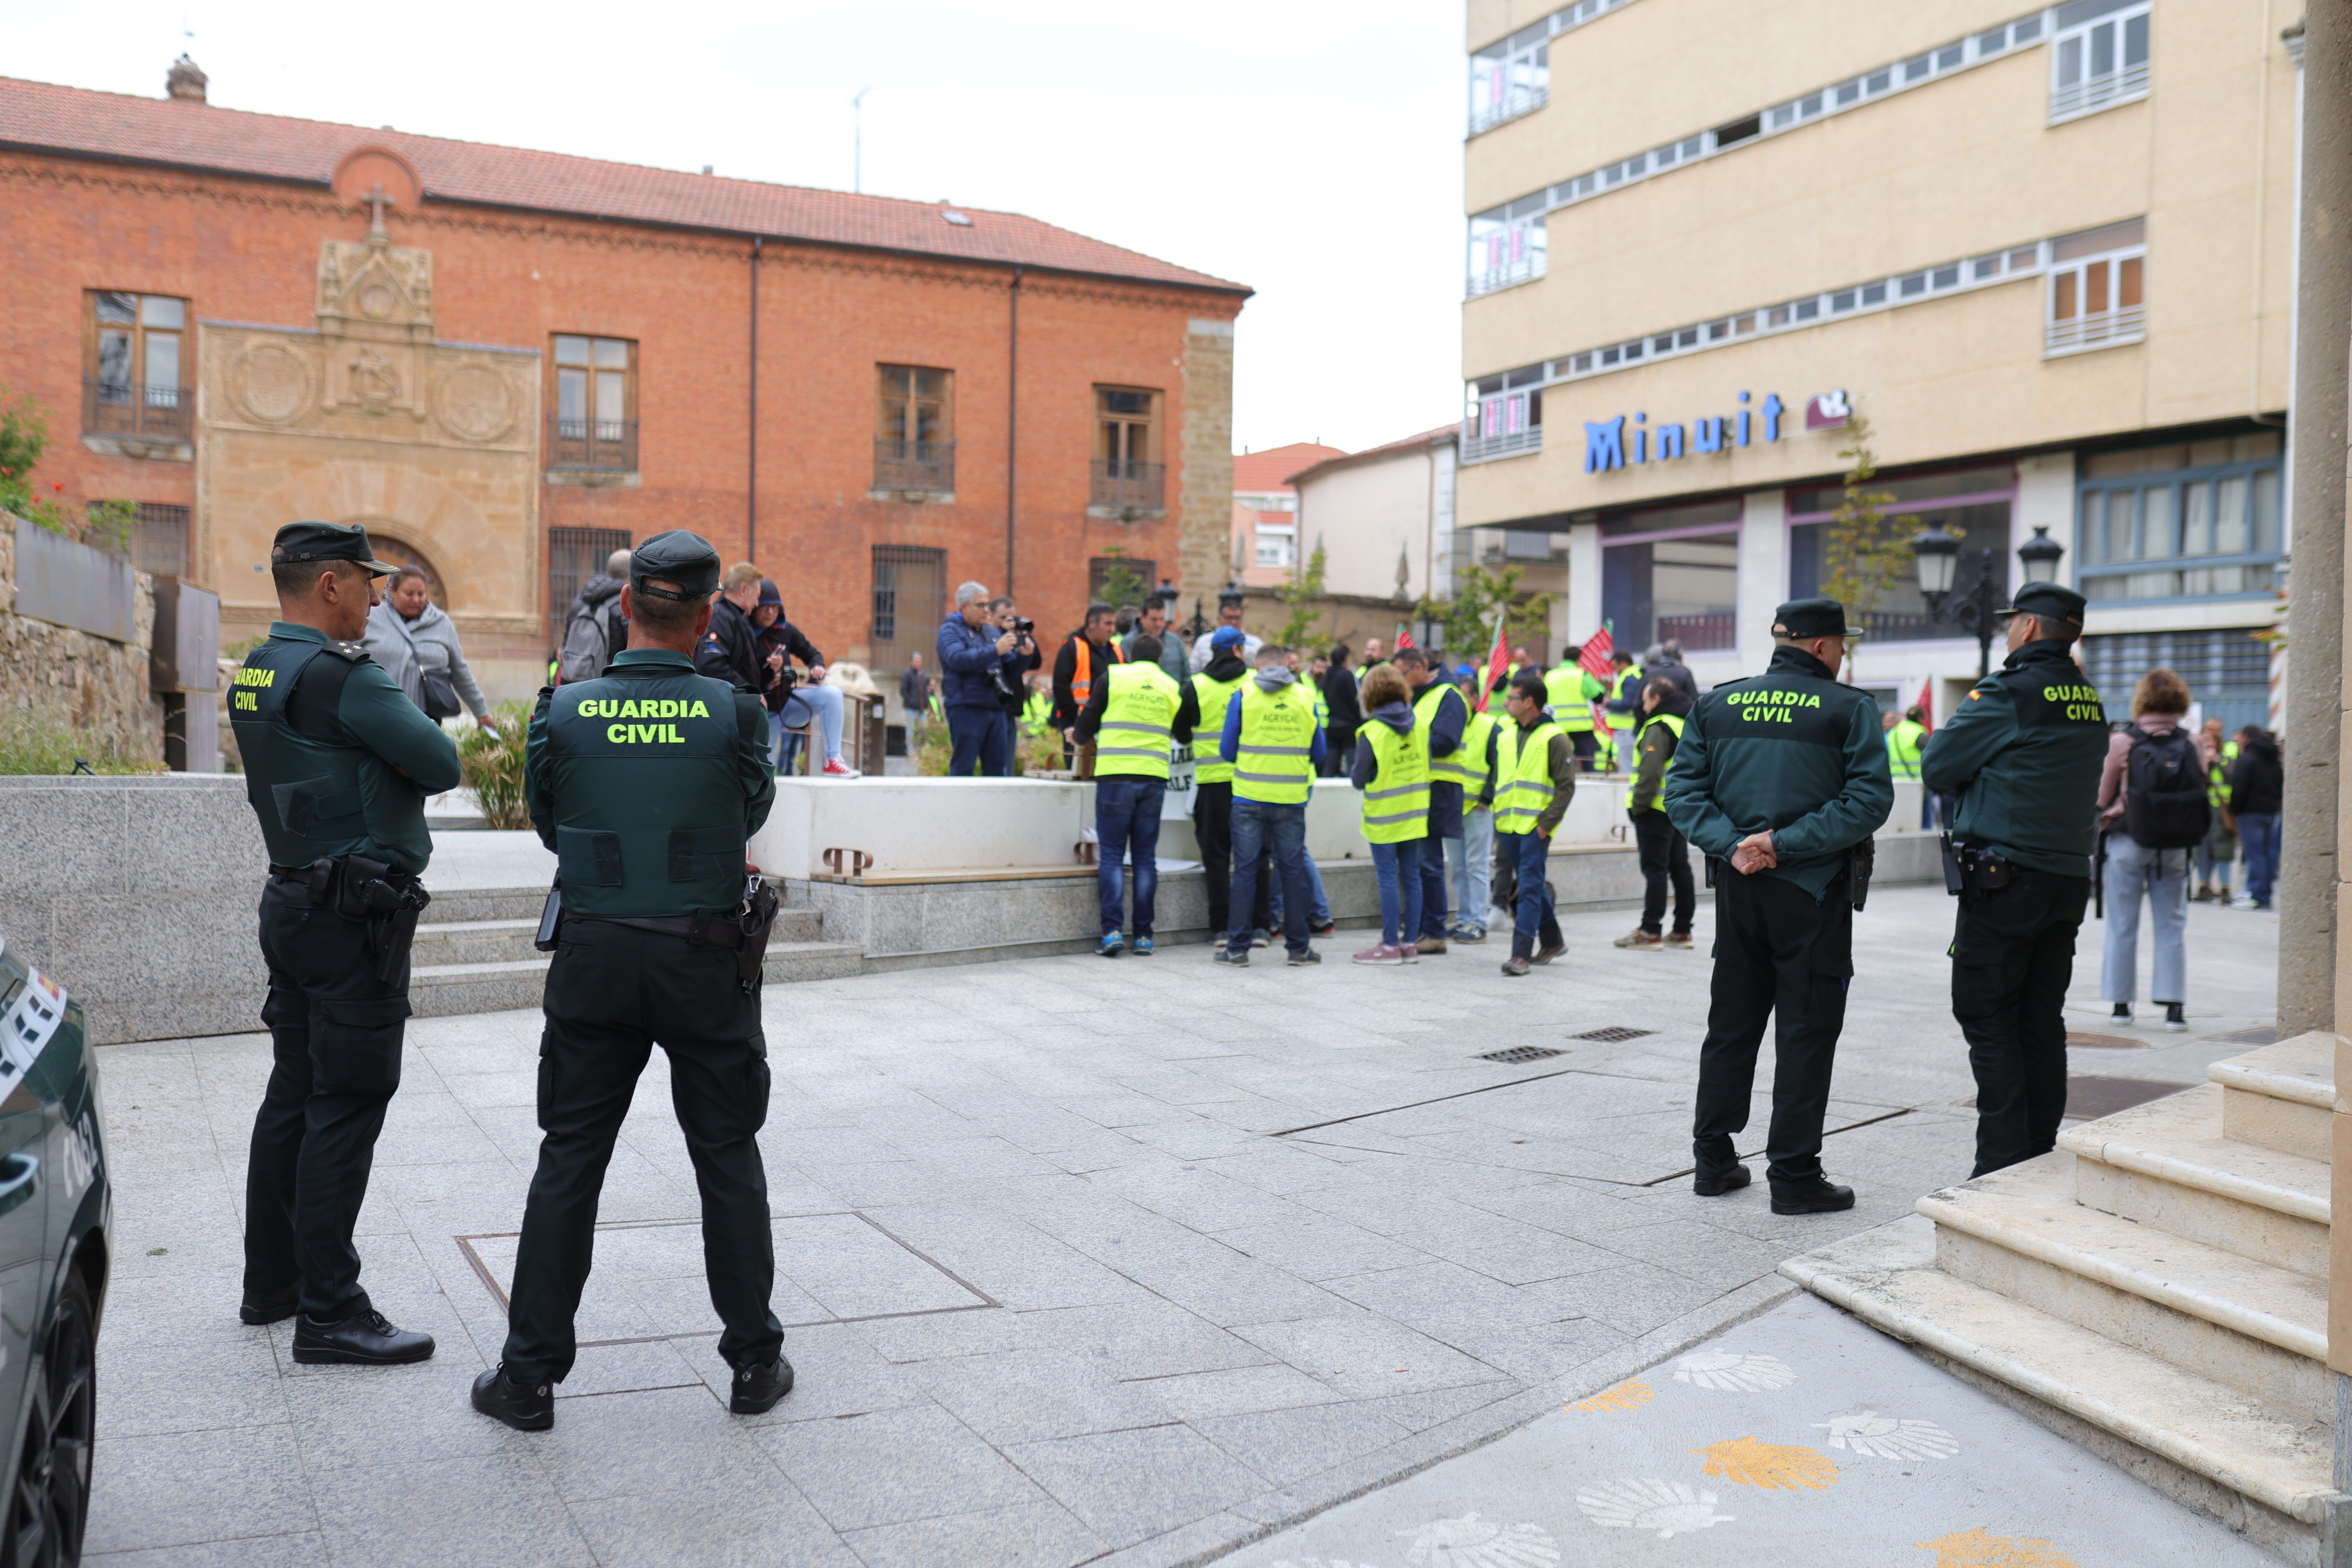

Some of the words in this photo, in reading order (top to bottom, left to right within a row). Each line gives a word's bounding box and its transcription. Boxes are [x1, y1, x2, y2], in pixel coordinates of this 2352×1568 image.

[1585, 392, 1783, 474] Minuit
[235, 691, 258, 711] CIVIL
[1727, 690, 1821, 708] GUARDIA
[578, 700, 710, 718] GUARDIA
[1742, 706, 1793, 723] CIVIL
[2066, 704, 2101, 721] CIVIL
[607, 724, 685, 743] CIVIL
